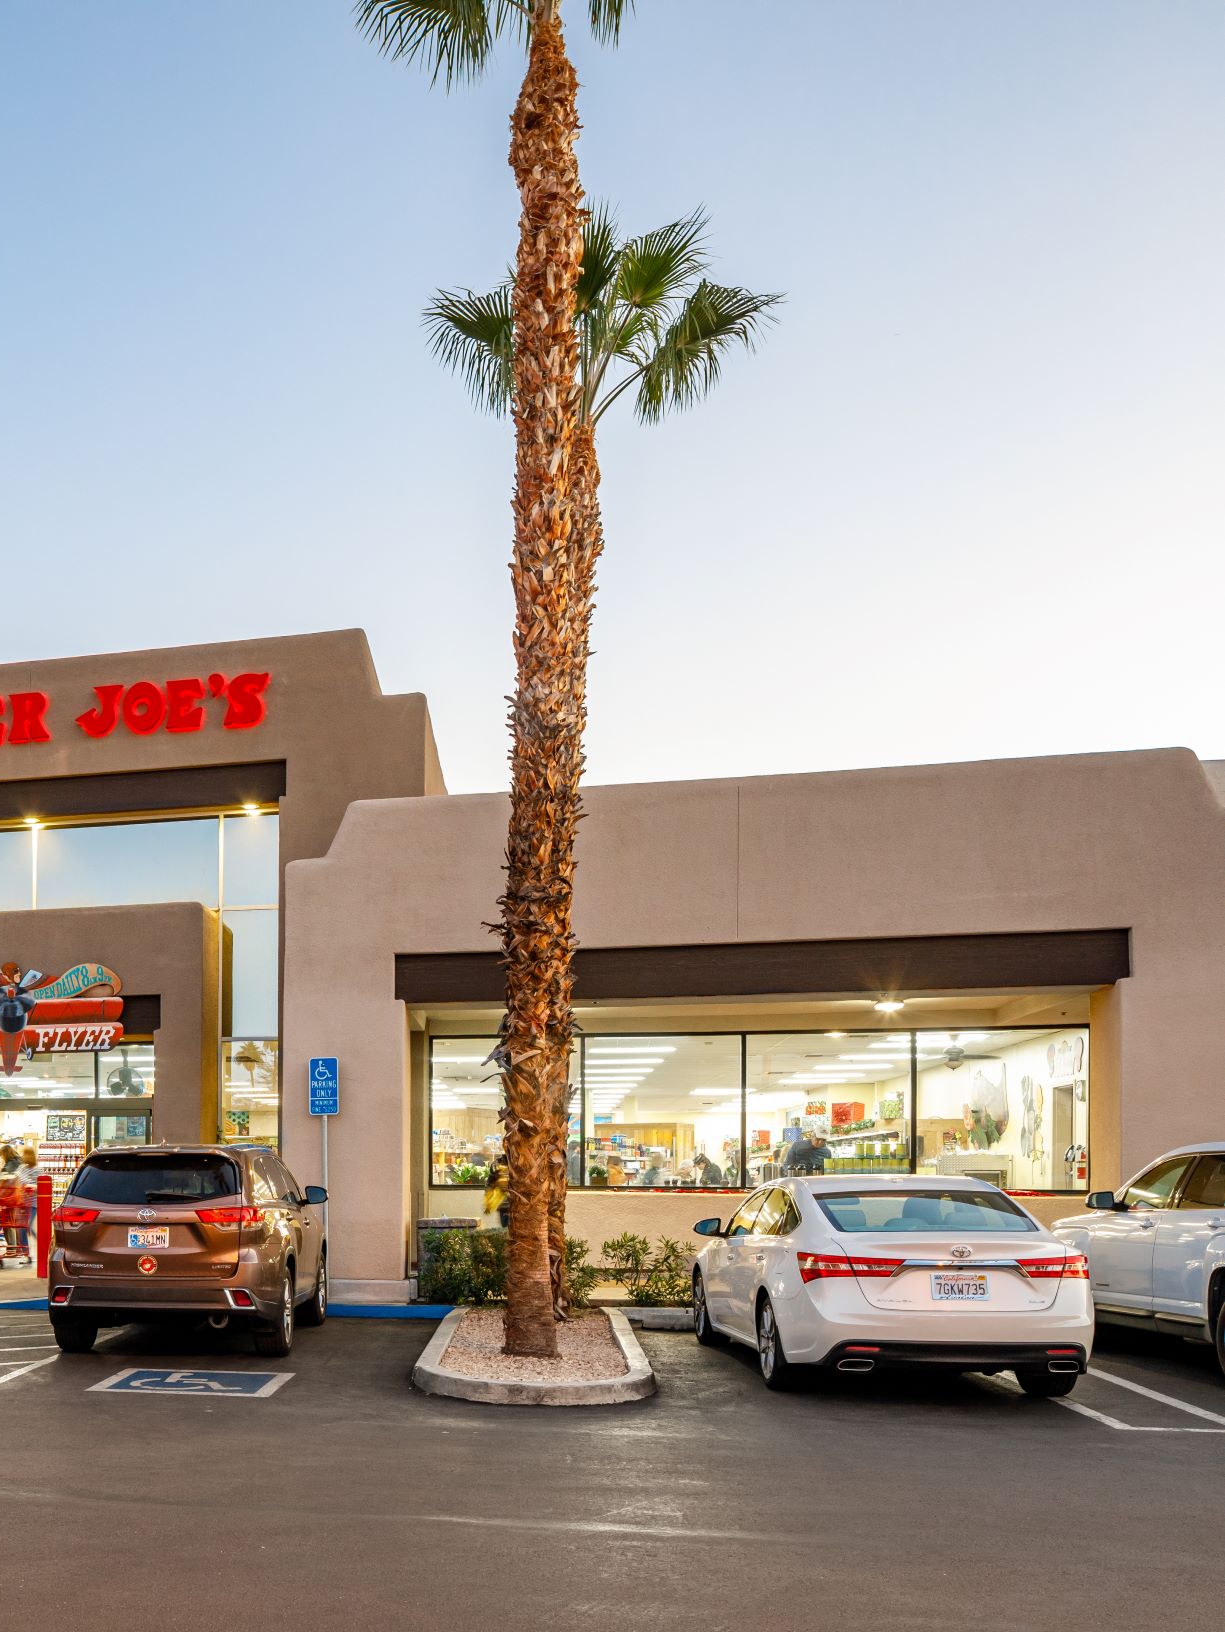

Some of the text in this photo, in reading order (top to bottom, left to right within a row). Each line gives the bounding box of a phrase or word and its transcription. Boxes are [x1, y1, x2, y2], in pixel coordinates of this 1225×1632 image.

[76, 671, 270, 738] JOE'S
[34, 984, 56, 999] OPEN
[56, 967, 83, 998] DAILY
[35, 1026, 117, 1051] FLYER
[311, 1080, 337, 1089] PARKING
[316, 1089, 332, 1098] ONLY
[936, 1282, 986, 1296] 7GKW735
